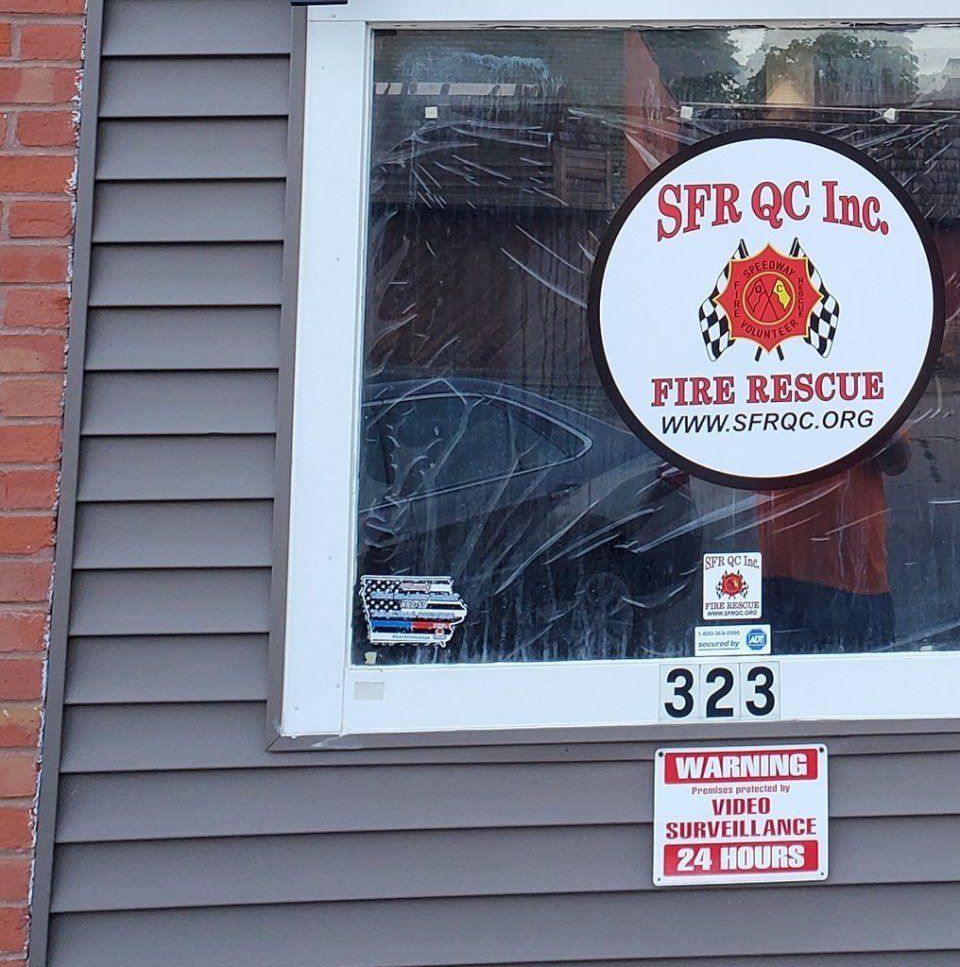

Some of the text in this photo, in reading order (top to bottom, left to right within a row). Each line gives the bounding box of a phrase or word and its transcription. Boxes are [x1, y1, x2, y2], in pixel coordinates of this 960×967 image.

[657, 180, 889, 242] SFR QC Inc.
[742, 260, 796, 278] SPEEDWAY
[740, 318, 798, 339] VOLUNTEER
[651, 371, 884, 407] FIRE RESCUE
[661, 410, 874, 434] WWW.SFRQC.ORG
[705, 555, 760, 570] SFR QC Inc.
[705, 601, 760, 610] FIRE RESCUE
[698, 640, 740, 648] secured by
[749, 635, 764, 644] ADT
[664, 666, 775, 718] 323
[675, 753, 808, 780] WARNING
[691, 784, 790, 795] Premises protected by
[712, 797, 771, 816] VIDEO
[665, 818, 817, 840] SURVEILLANCE
[677, 845, 806, 872] 24 HOURS
